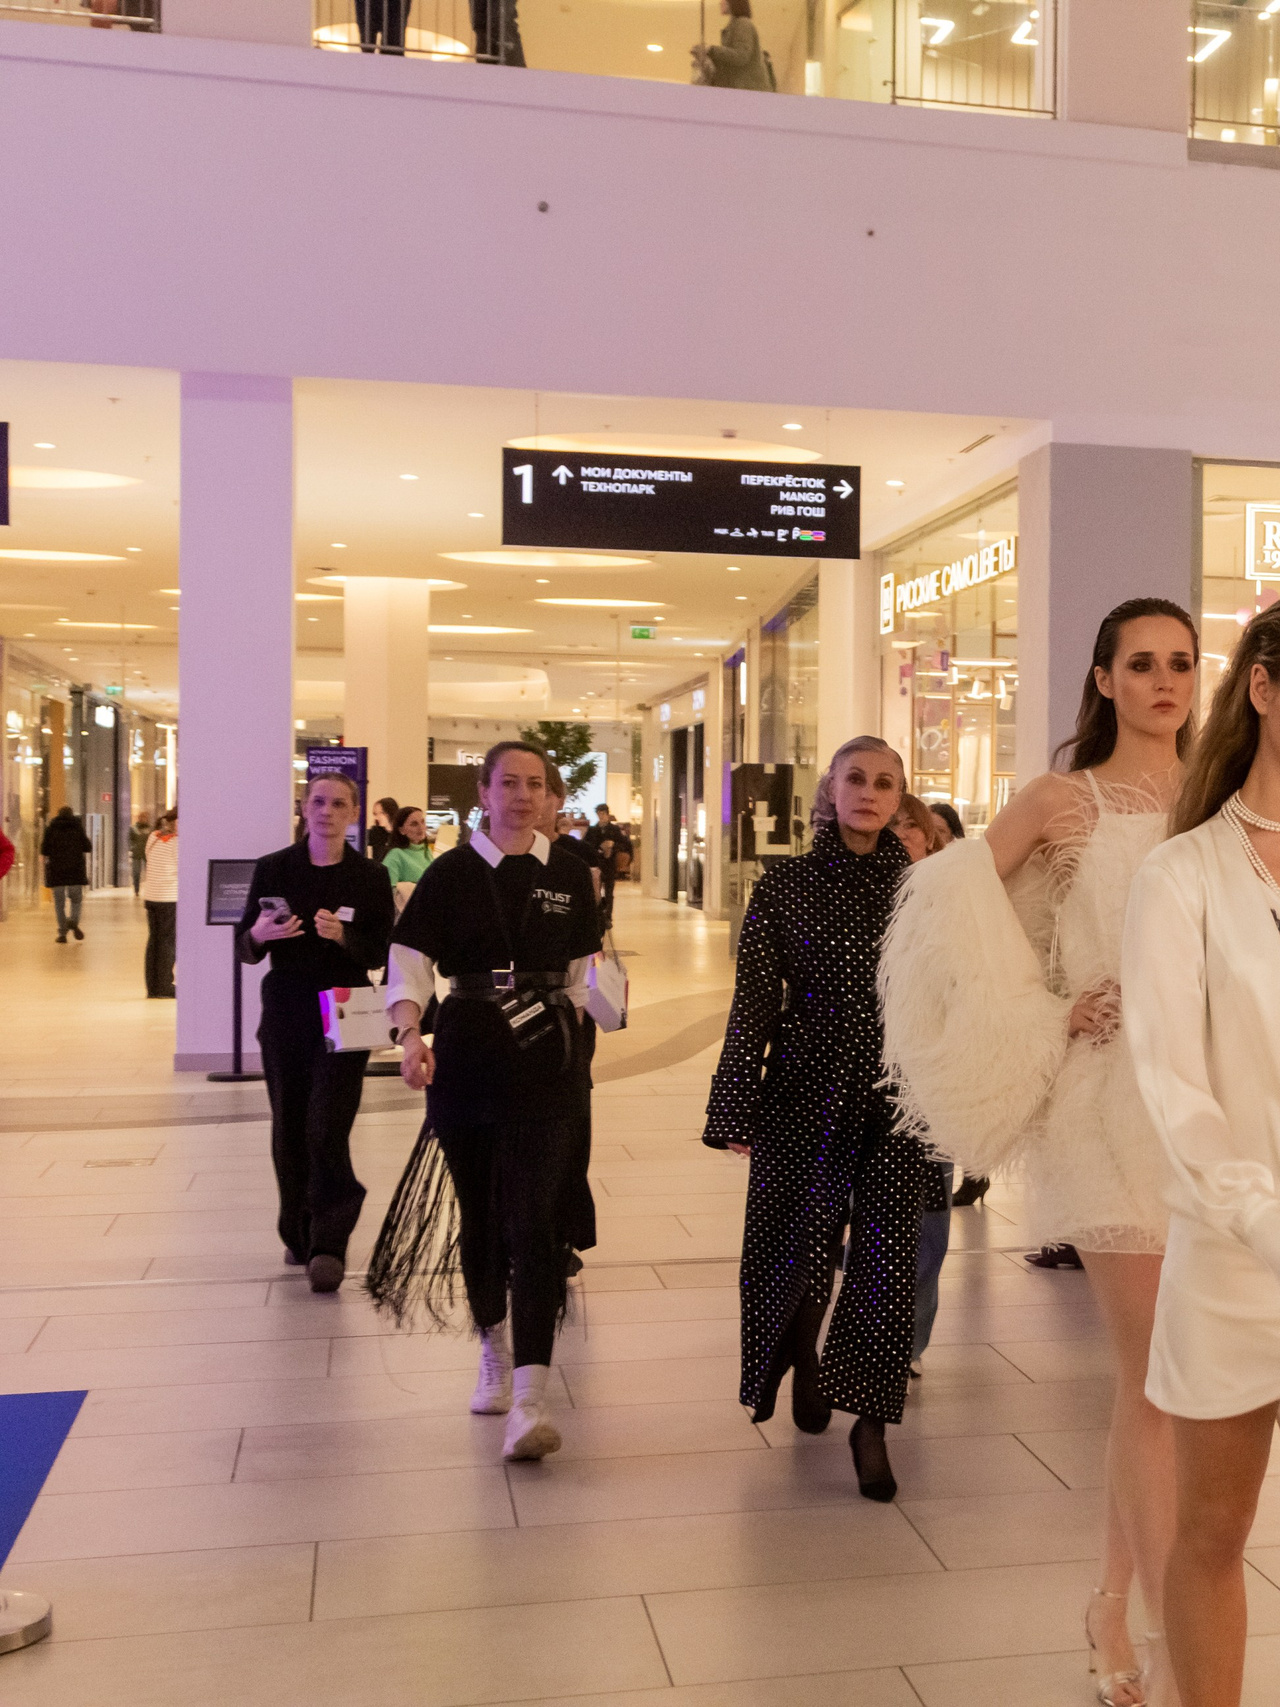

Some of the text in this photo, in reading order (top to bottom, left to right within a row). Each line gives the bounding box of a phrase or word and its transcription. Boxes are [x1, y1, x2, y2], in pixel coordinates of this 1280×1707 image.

[580, 466, 693, 482] МОИ ДОКУМЕНТЫ
[740, 474, 826, 489] ПЕРЕКРЁСТОК
[512, 464, 534, 504] 1
[580, 481, 656, 495] ТЕХНОПАРК
[779, 491, 827, 503] MANGO
[770, 505, 826, 518] РИВ ГОШ
[941, 535, 1016, 596] САМОЦВЕТЫ
[309, 755, 357, 765] FASHION
[532, 888, 572, 904] TYLIST
